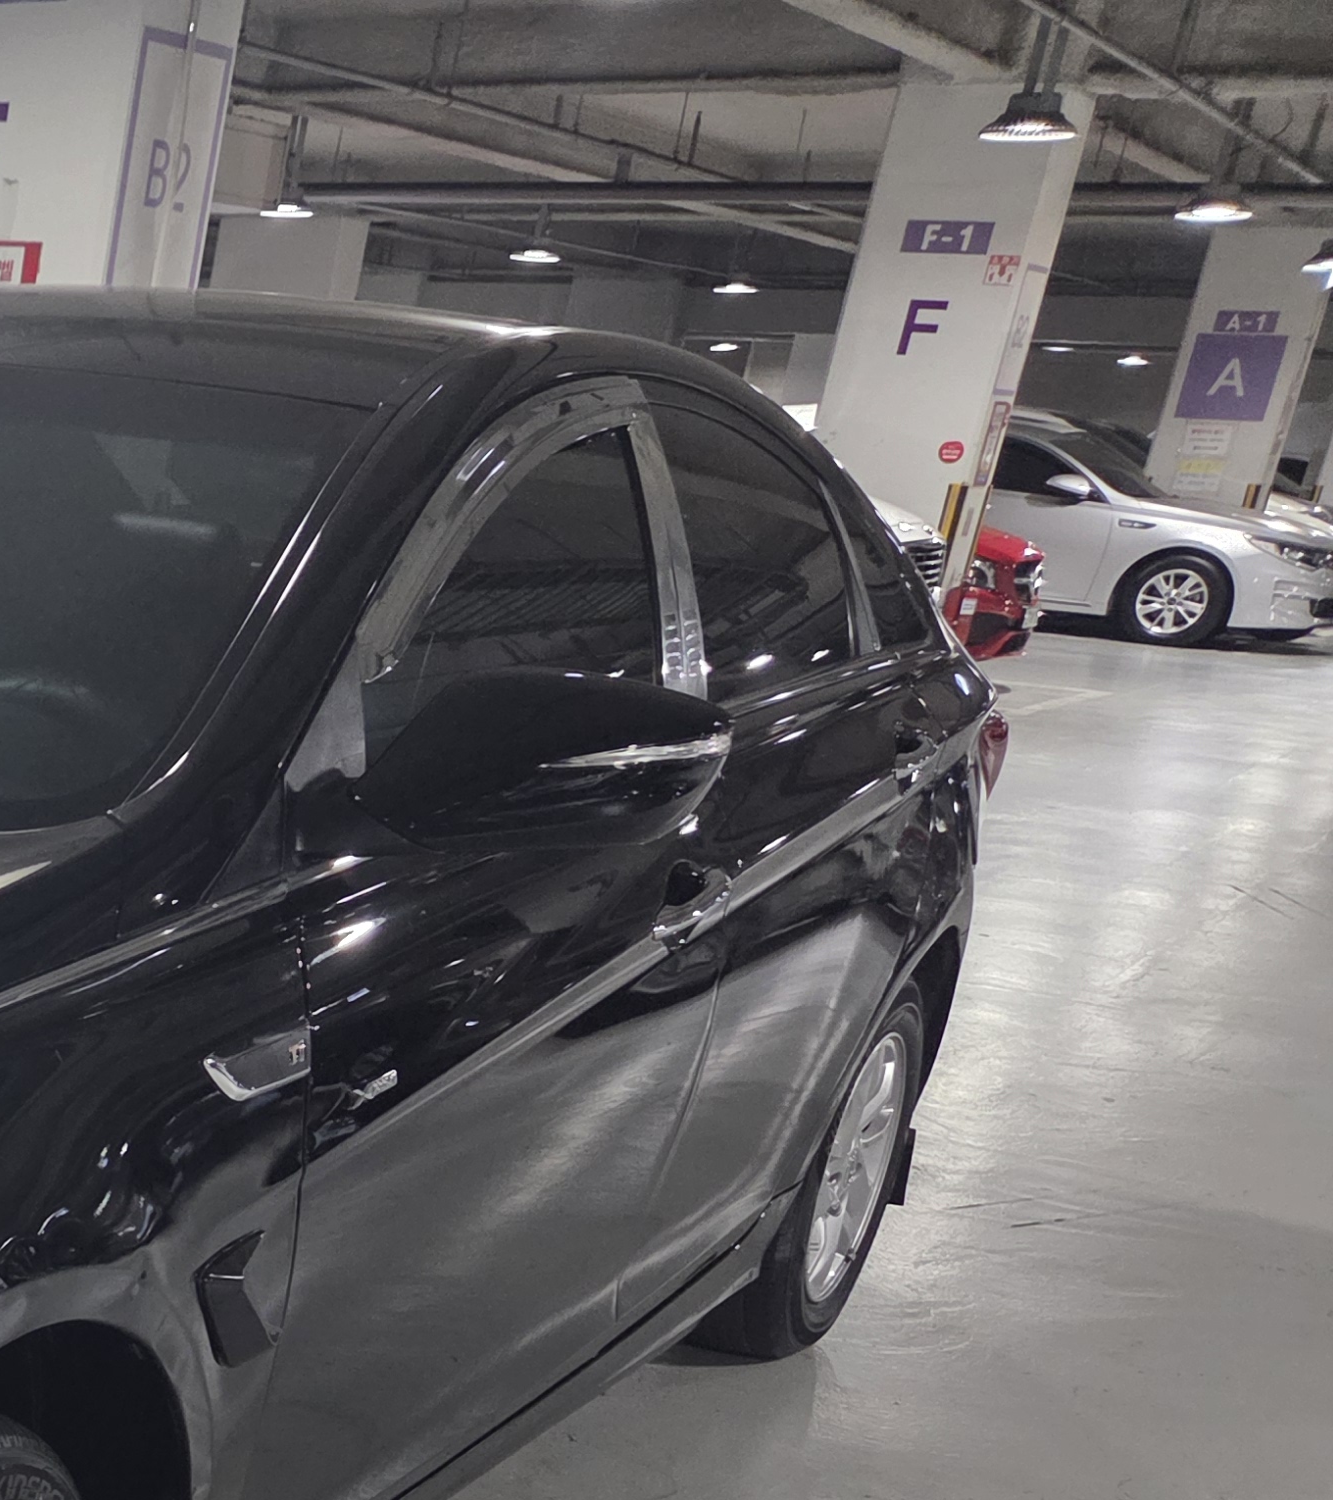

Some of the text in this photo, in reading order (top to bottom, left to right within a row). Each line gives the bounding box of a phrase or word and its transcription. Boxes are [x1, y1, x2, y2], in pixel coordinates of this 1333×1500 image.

[143, 139, 192, 213] B2
[920, 223, 975, 252] F-1
[896, 299, 949, 355] F
[1224, 313, 1268, 332] A-1
[1205, 357, 1244, 397] A
